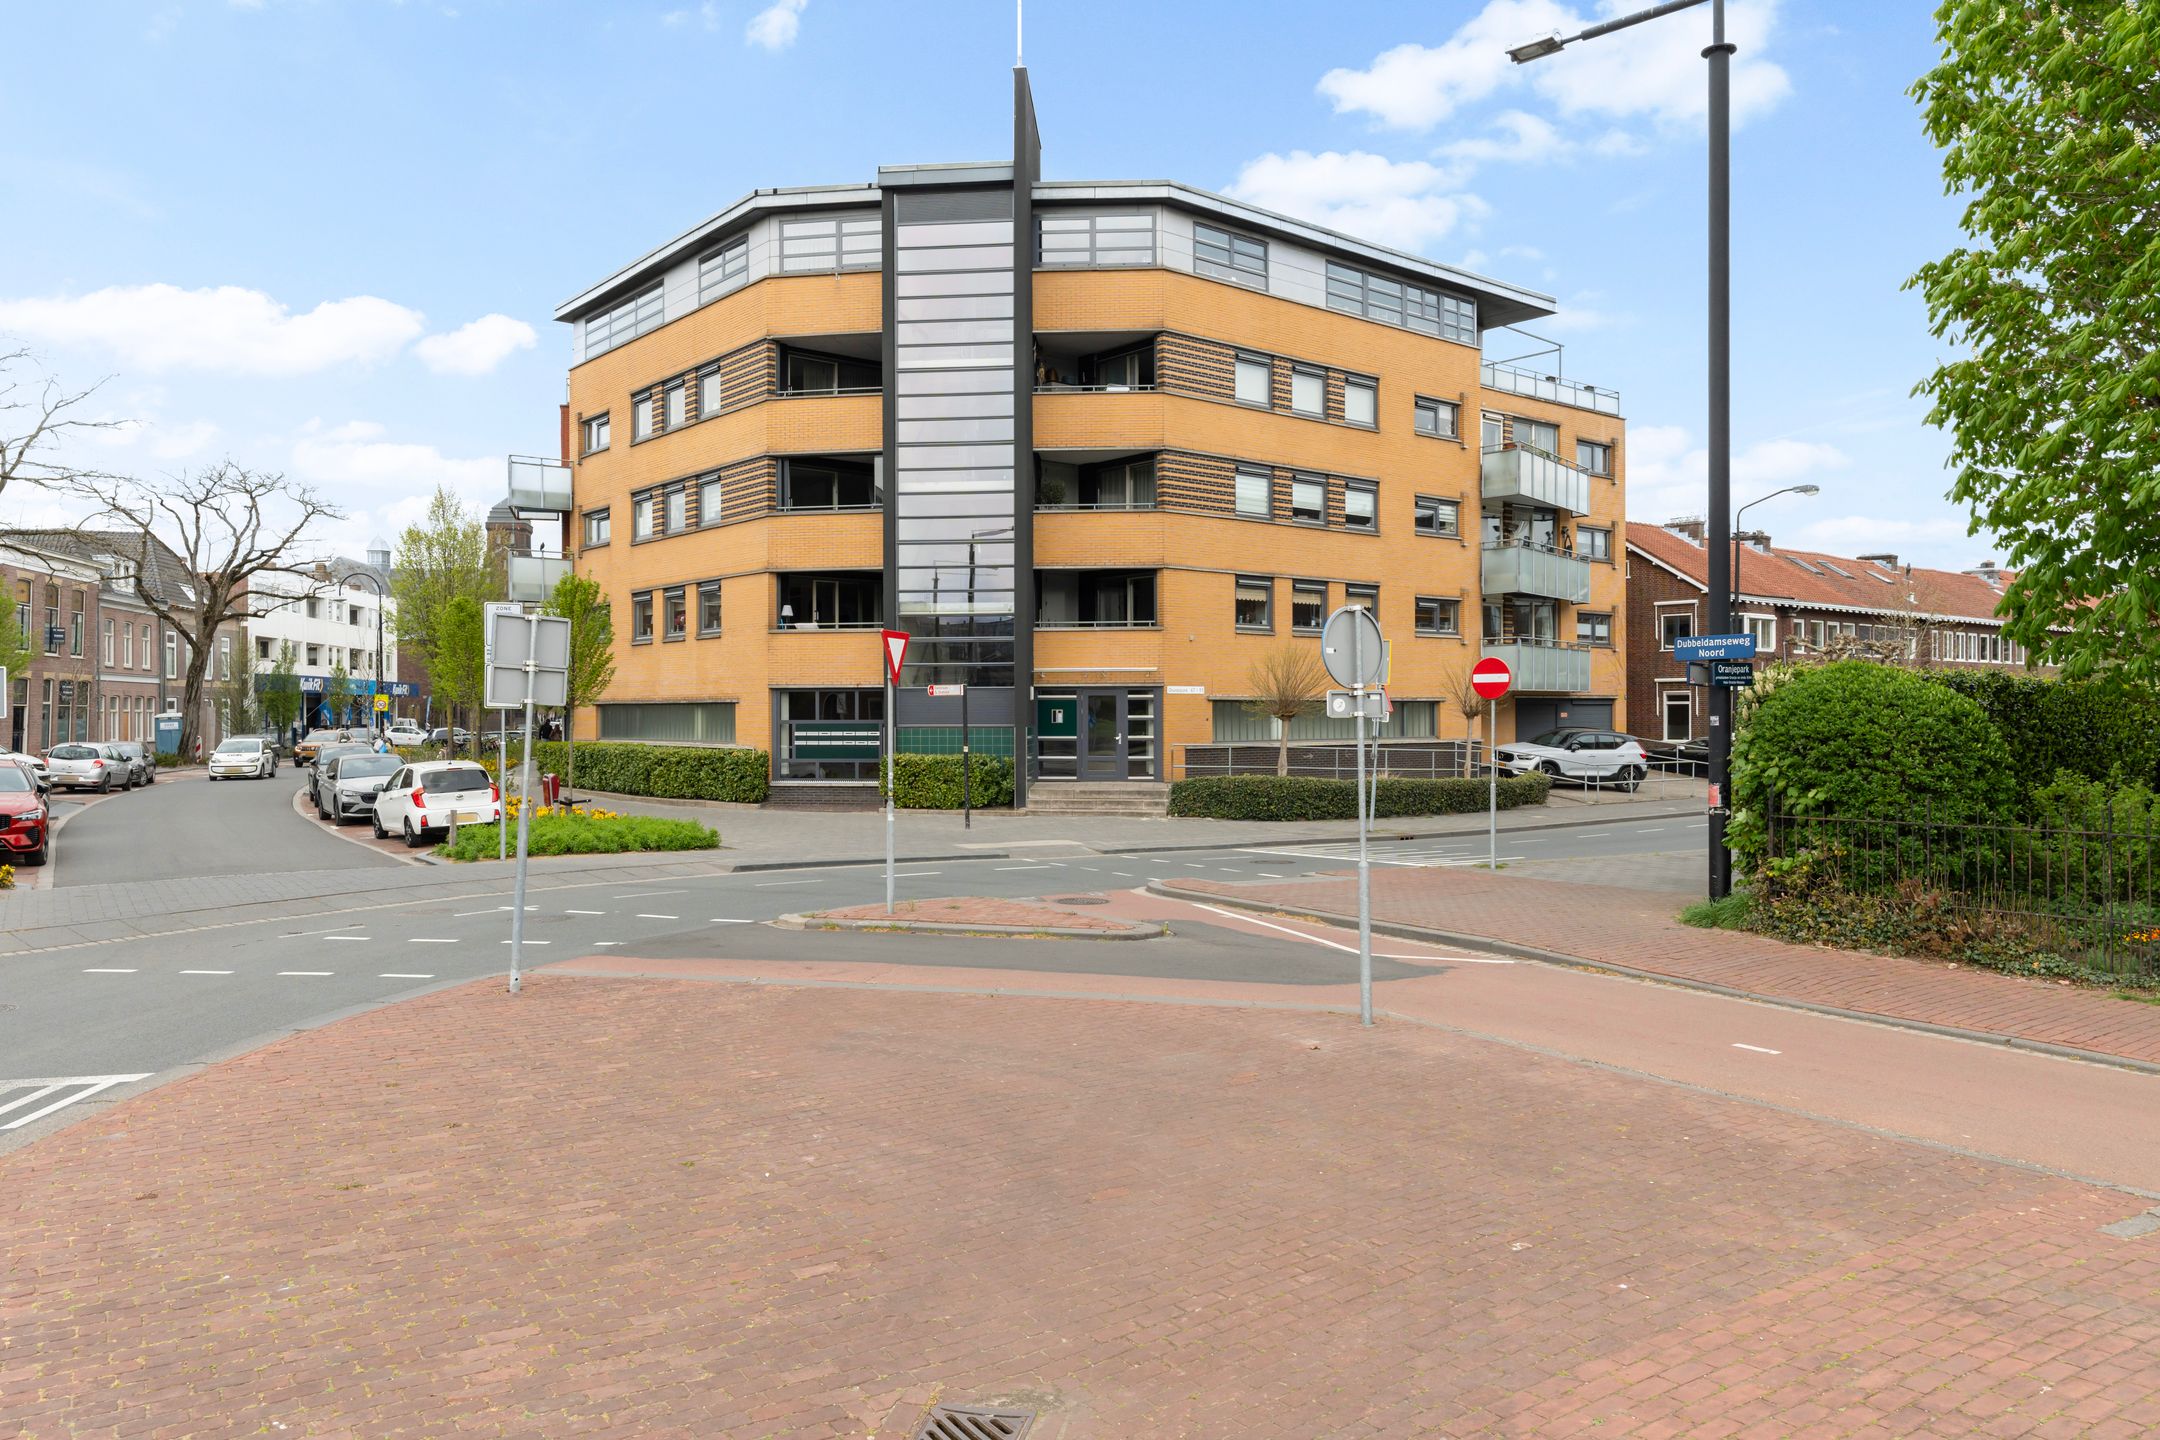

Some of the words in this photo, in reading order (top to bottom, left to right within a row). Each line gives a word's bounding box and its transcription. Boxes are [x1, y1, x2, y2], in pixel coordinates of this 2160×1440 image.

[1677, 637, 1751, 648] Dubbeldamseweg
[1698, 648, 1725, 657] Noord
[1718, 664, 1750, 675] Oranjepark
